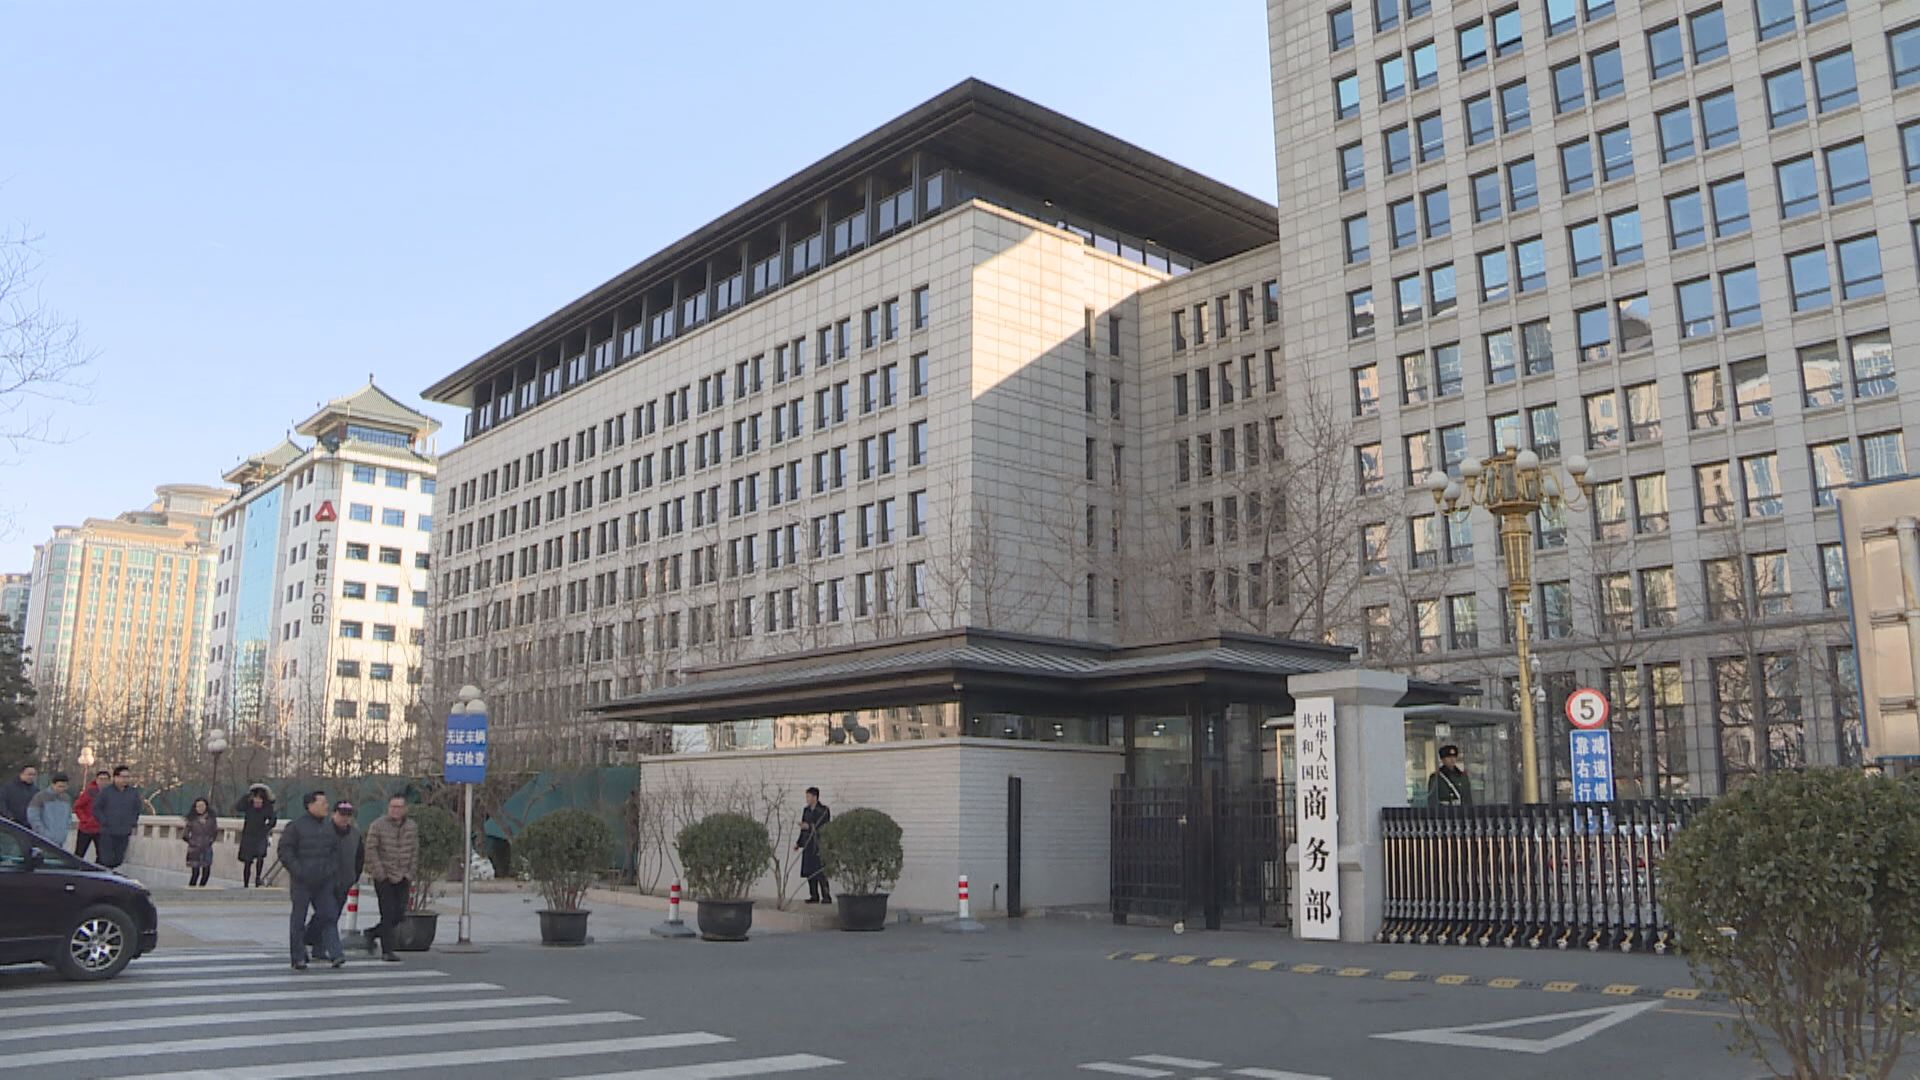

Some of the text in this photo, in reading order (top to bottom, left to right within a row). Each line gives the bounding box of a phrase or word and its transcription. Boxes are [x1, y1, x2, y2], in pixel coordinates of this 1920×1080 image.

[311, 528, 331, 626] 广发银行 CGB
[446, 729, 486, 744] 无证车辆
[1580, 698, 1595, 720] 5
[446, 751, 485, 766] 靠右检查
[1301, 712, 1314, 781] 共和国
[1315, 711, 1329, 781] 中华人民
[1575, 736, 1592, 824] 靠右行
[1302, 784, 1332, 925] 商务部
